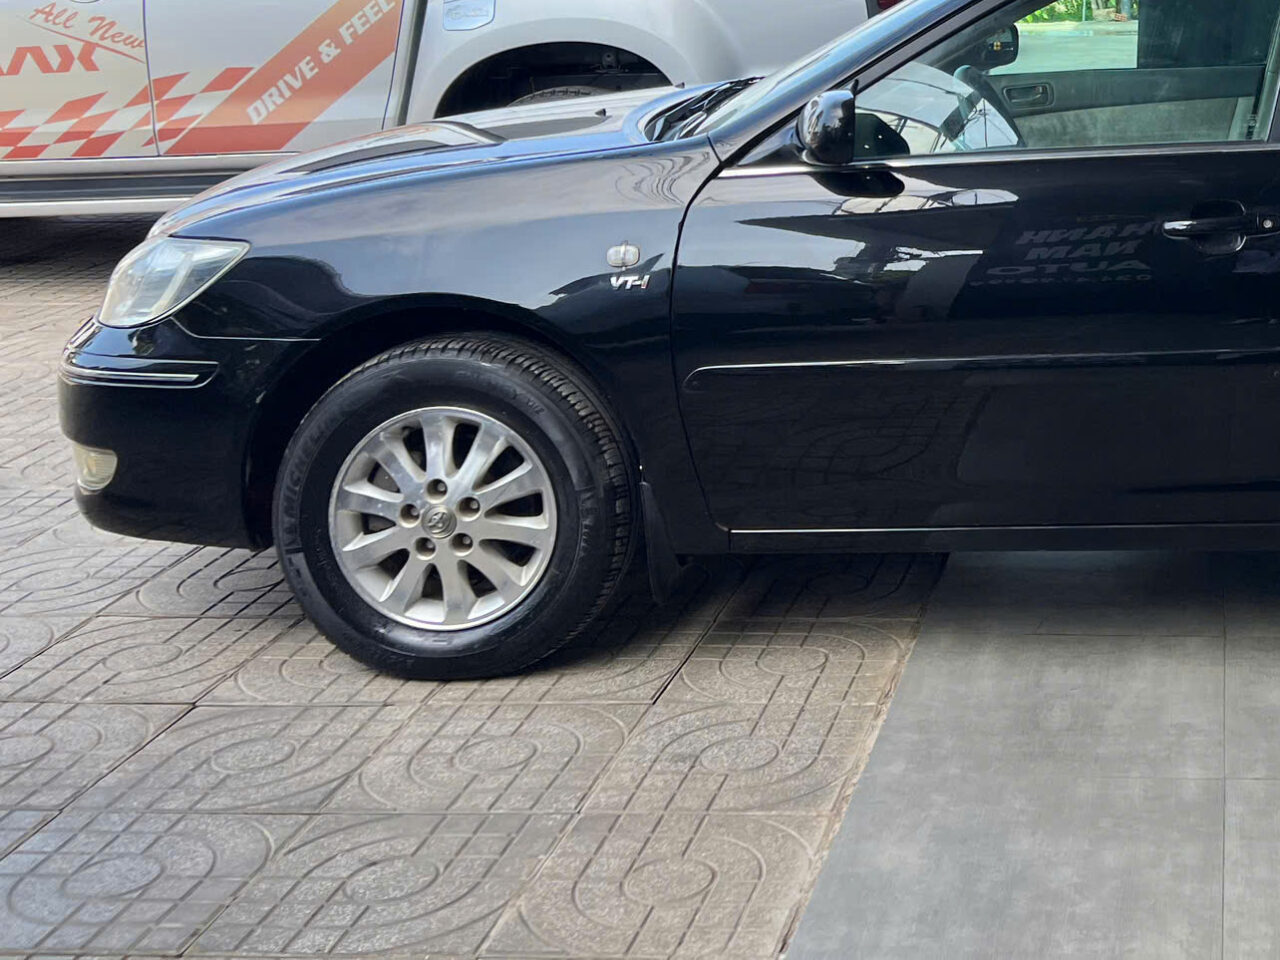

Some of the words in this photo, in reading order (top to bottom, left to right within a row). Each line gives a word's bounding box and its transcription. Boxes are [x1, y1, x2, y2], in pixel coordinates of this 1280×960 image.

[29, 2, 79, 29] All
[88, 16, 144, 48] New
[0, 44, 100, 76] AX
[246, 55, 319, 125] DRIVE
[318, 38, 341, 64] &
